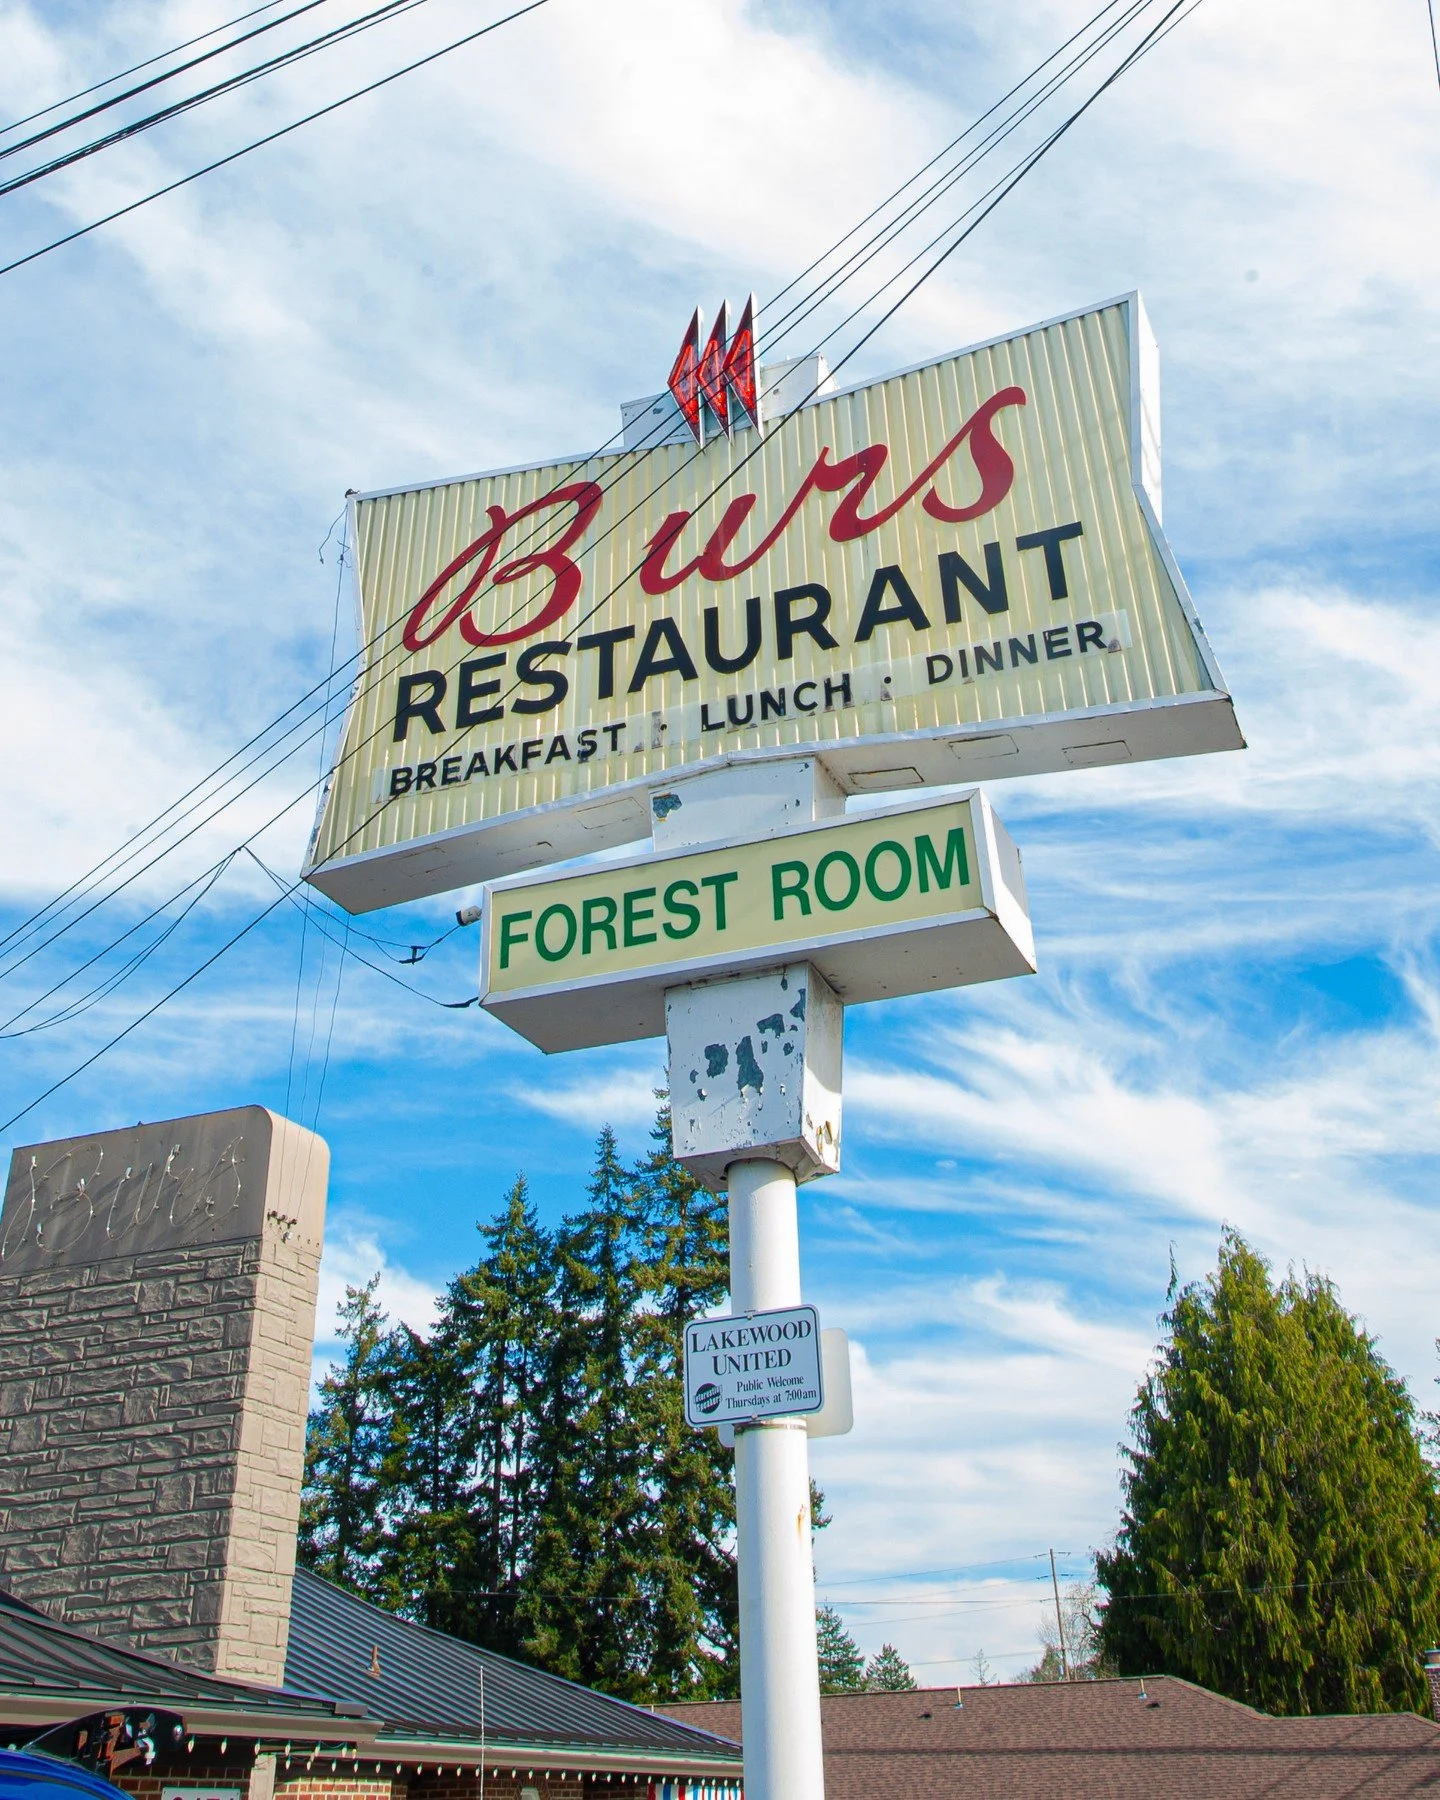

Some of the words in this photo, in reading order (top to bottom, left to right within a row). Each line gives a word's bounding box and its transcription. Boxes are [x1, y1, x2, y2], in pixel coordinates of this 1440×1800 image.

[402, 386, 1026, 652] Burs
[393, 521, 1083, 743] RESTAURANT
[389, 723, 627, 796] BREAKFAST
[701, 673, 852, 732] LUNCH
[926, 620, 1107, 685] DINNER
[499, 871, 739, 970] FOREST
[771, 827, 971, 921] ROOM
[691, 1319, 812, 1354] LAKEWOOD
[712, 1348, 792, 1376] UNITED
[725, 1394, 771, 1409] Thursdays
[773, 1393, 781, 1403] at
[736, 1378, 764, 1393] Public
[766, 1375, 805, 1388] Welcome
